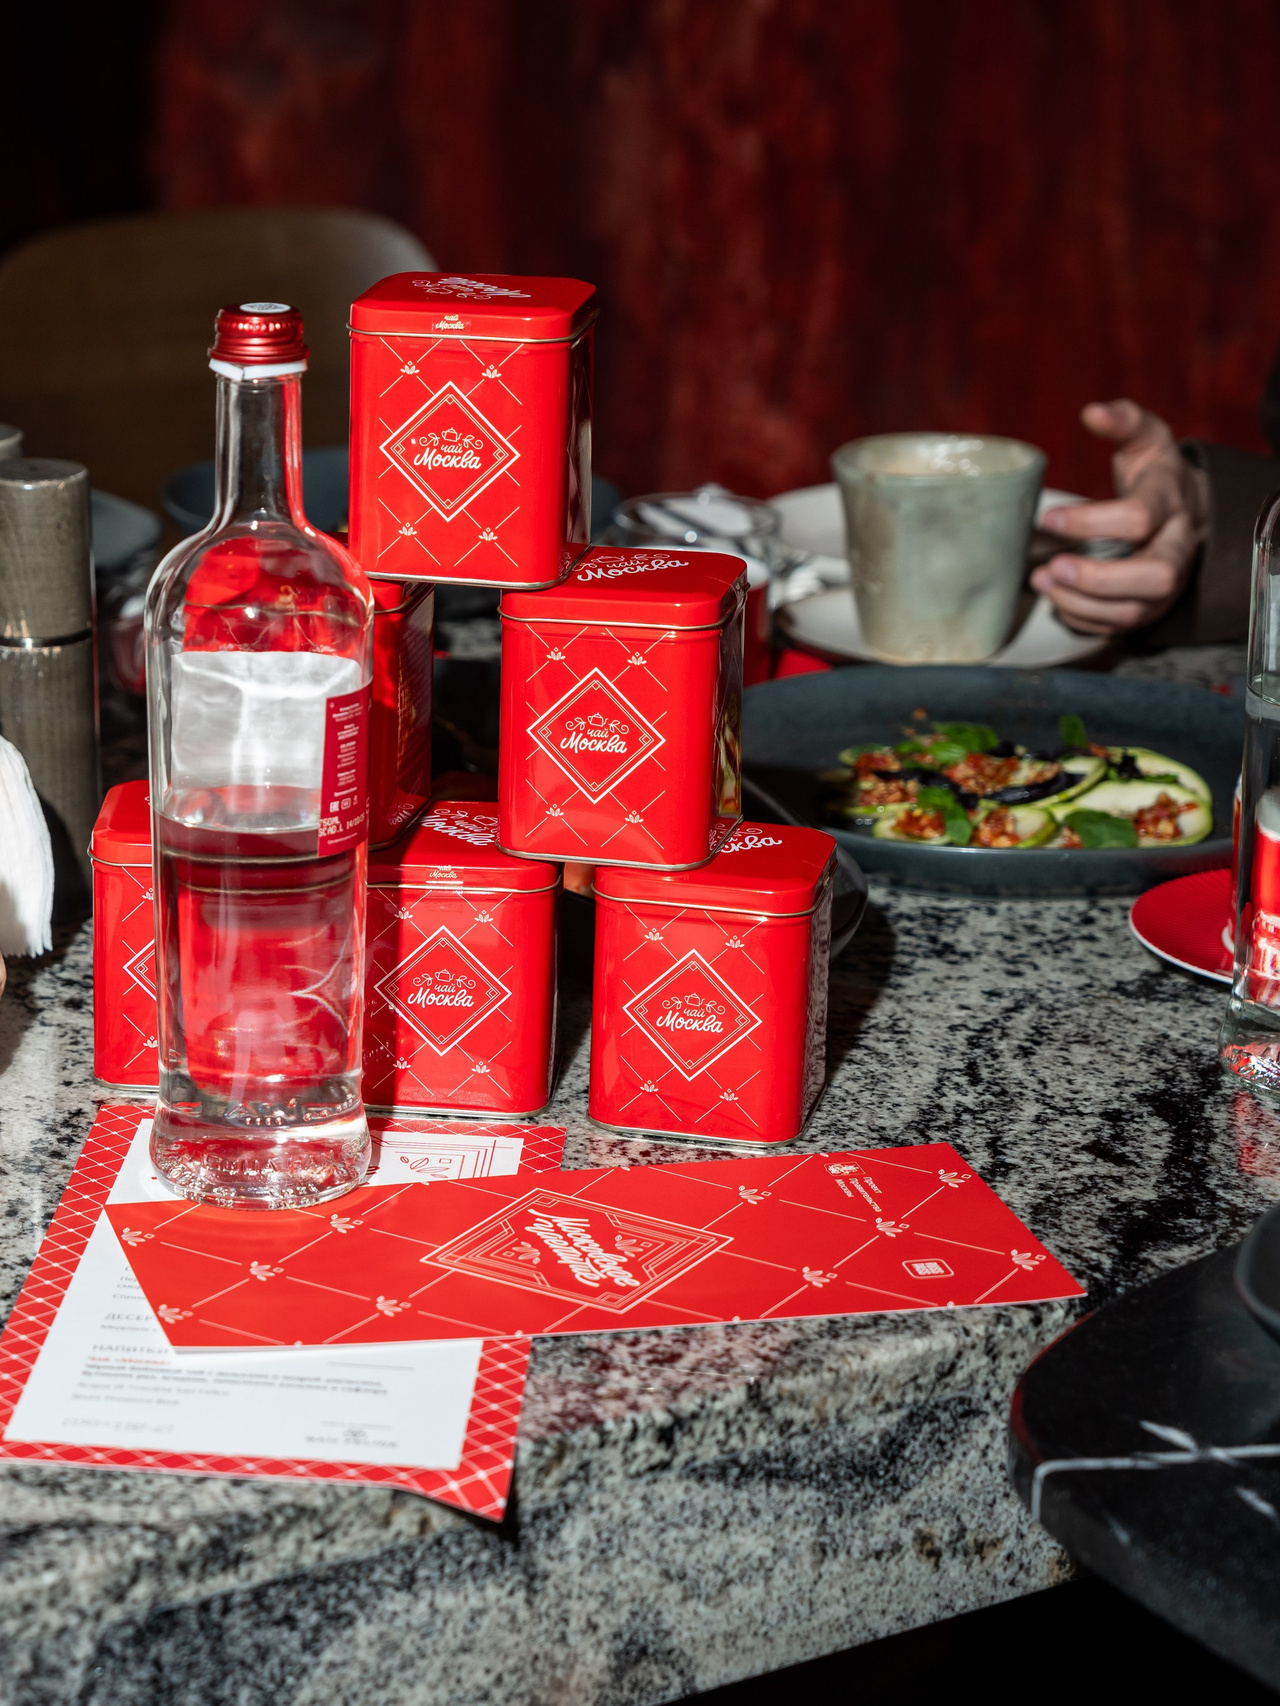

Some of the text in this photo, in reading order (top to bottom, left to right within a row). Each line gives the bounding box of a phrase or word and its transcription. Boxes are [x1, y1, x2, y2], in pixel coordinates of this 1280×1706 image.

[440, 443, 463, 454] чай
[413, 447, 482, 470] Москва
[577, 559, 689, 581] Москва
[586, 728, 609, 738] чай
[560, 731, 628, 754] Москва
[716, 835, 783, 854] сква
[429, 870, 458, 879] Москва
[433, 983, 456, 993] чай
[407, 987, 474, 1009] Москва
[656, 1010, 724, 1033] Москва
[683, 1007, 705, 1018] чай
[863, 1177, 882, 1194] Проект
[527, 1208, 641, 1287] Московское
[104, 1312, 154, 1321] ДЕСЕР
